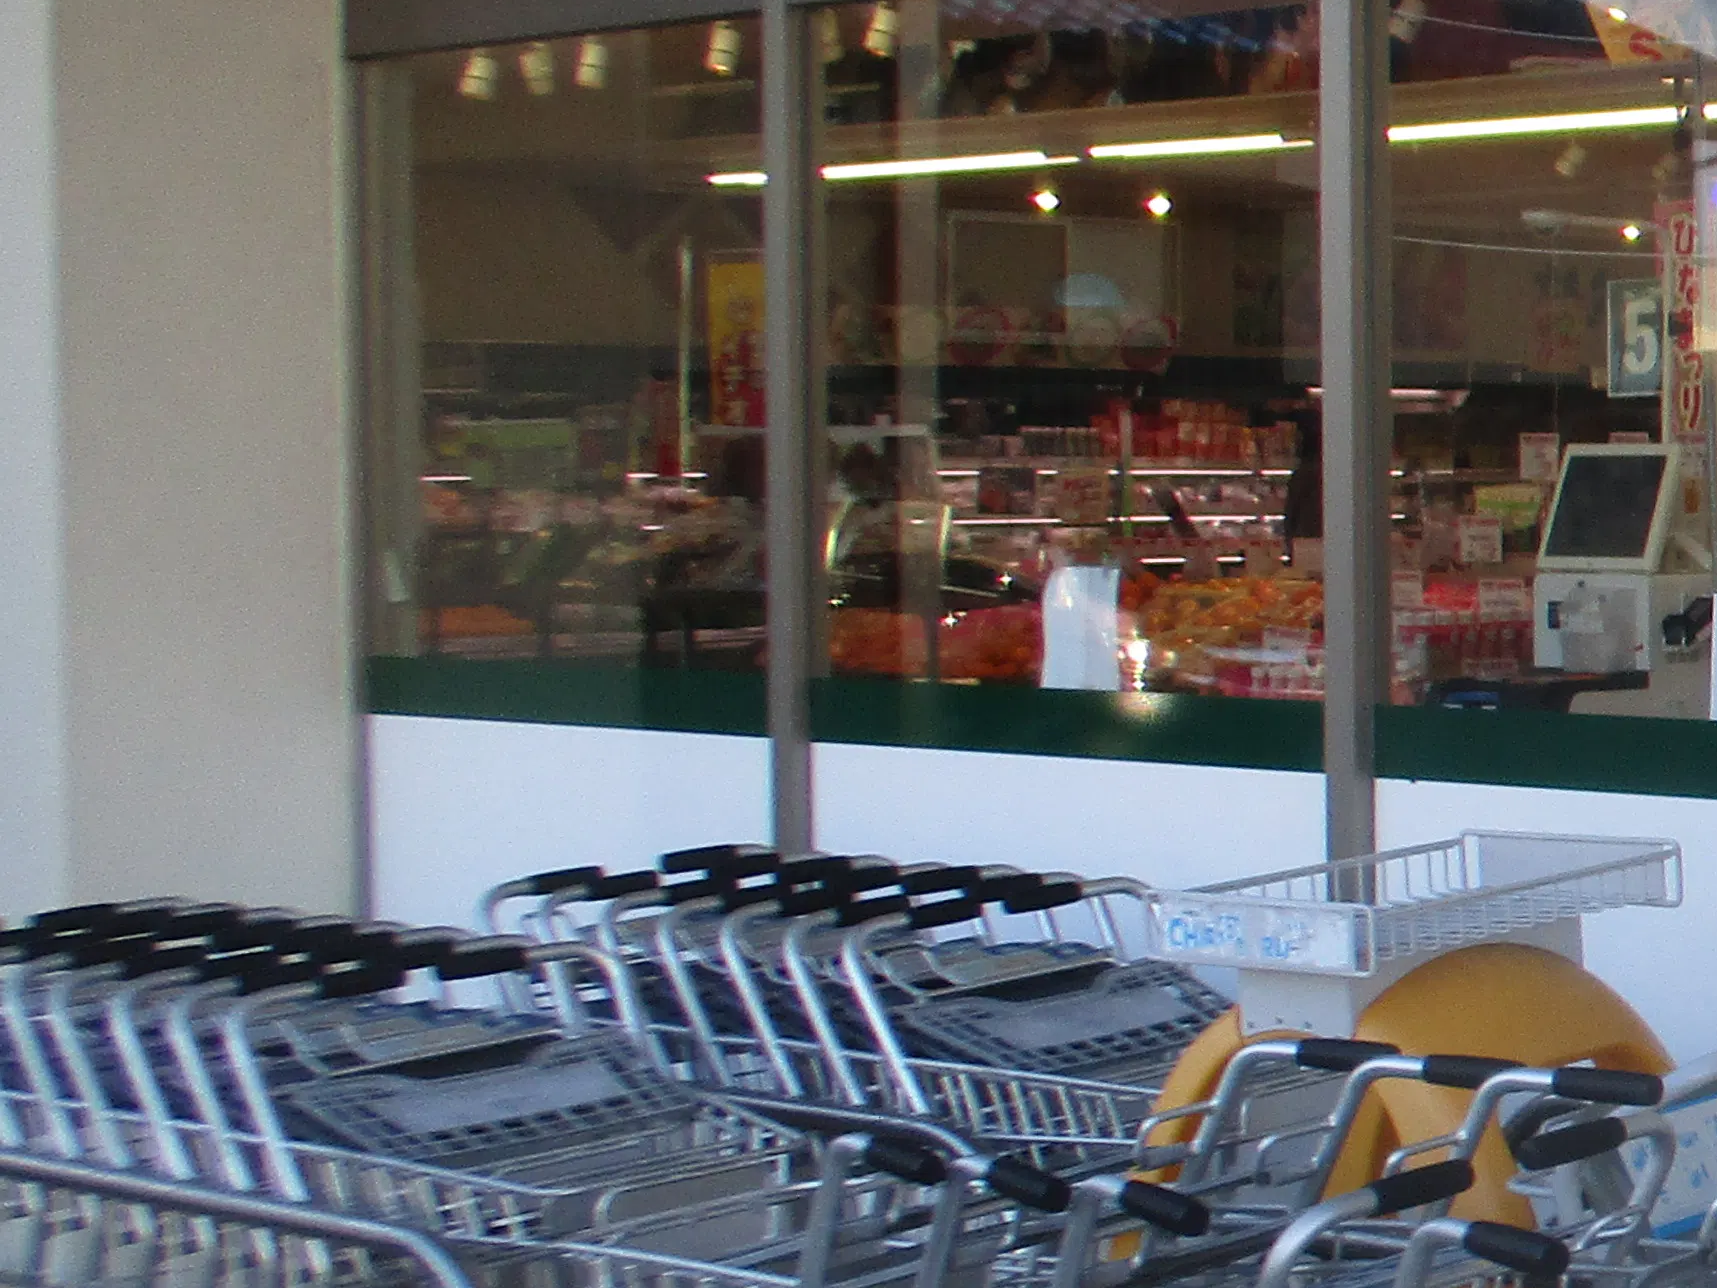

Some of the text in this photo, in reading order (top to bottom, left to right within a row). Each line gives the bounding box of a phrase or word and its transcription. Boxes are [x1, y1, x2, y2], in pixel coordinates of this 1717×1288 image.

[1622, 295, 1660, 374] 5
[1671, 214, 1703, 430] ひなまつり
